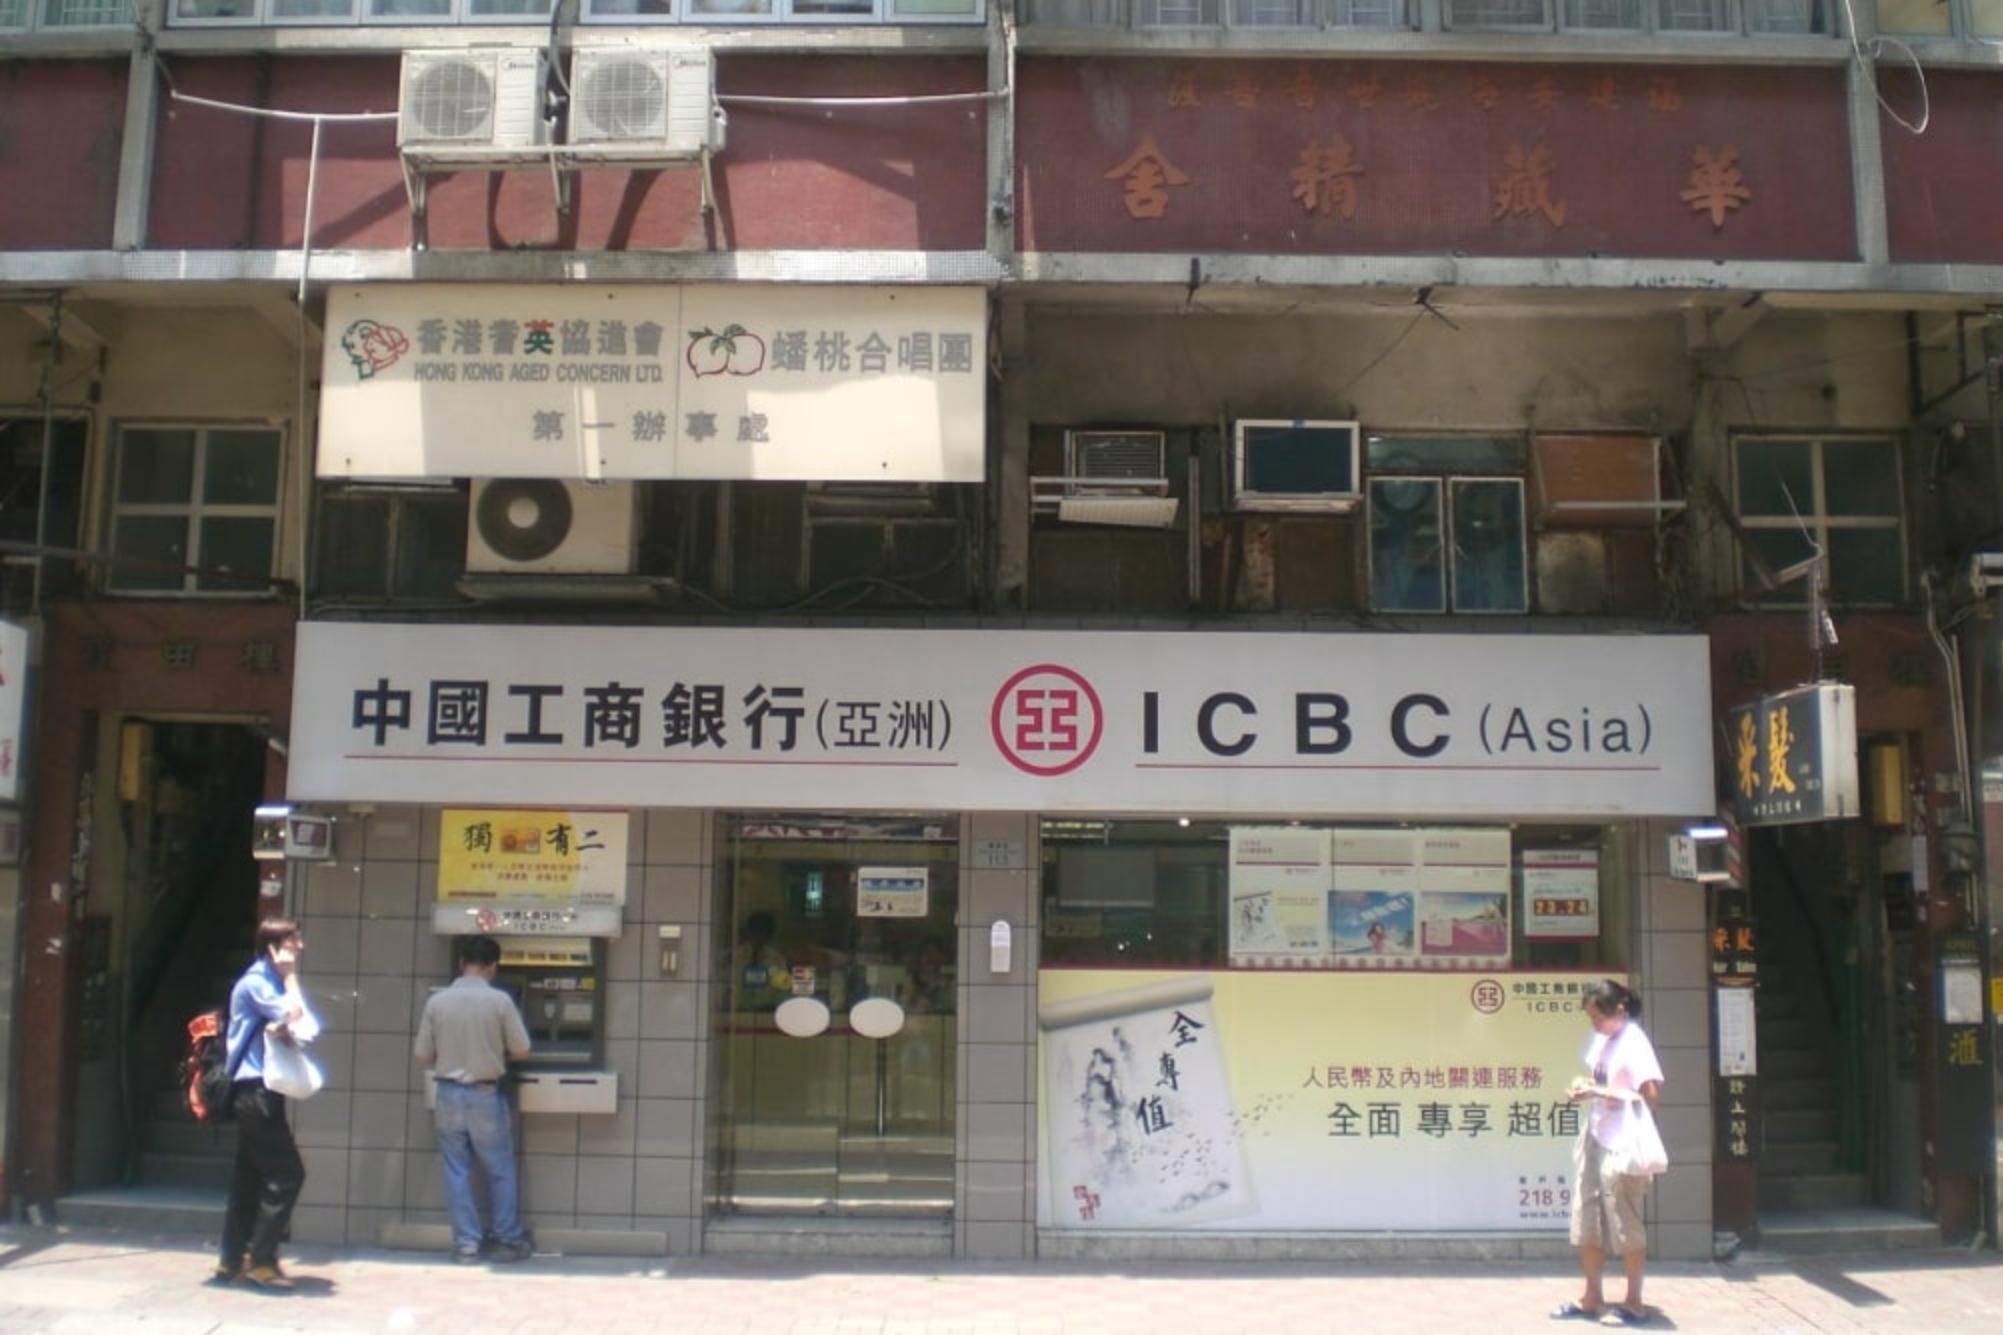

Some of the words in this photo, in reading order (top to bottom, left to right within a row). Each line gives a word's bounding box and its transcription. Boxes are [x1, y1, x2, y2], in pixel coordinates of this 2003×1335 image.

[771, 330, 972, 373] 蟠桃合唱團
[414, 363, 455, 381] HONG
[462, 363, 503, 381] KONG
[509, 364, 549, 381] AGED
[556, 364, 631, 382] CONCERN
[1142, 691, 1451, 758] ICBC
[1479, 703, 1651, 756] (Asia)
[1527, 1001, 1573, 1013] ICBC
[1519, 1189, 1553, 1207] 218
